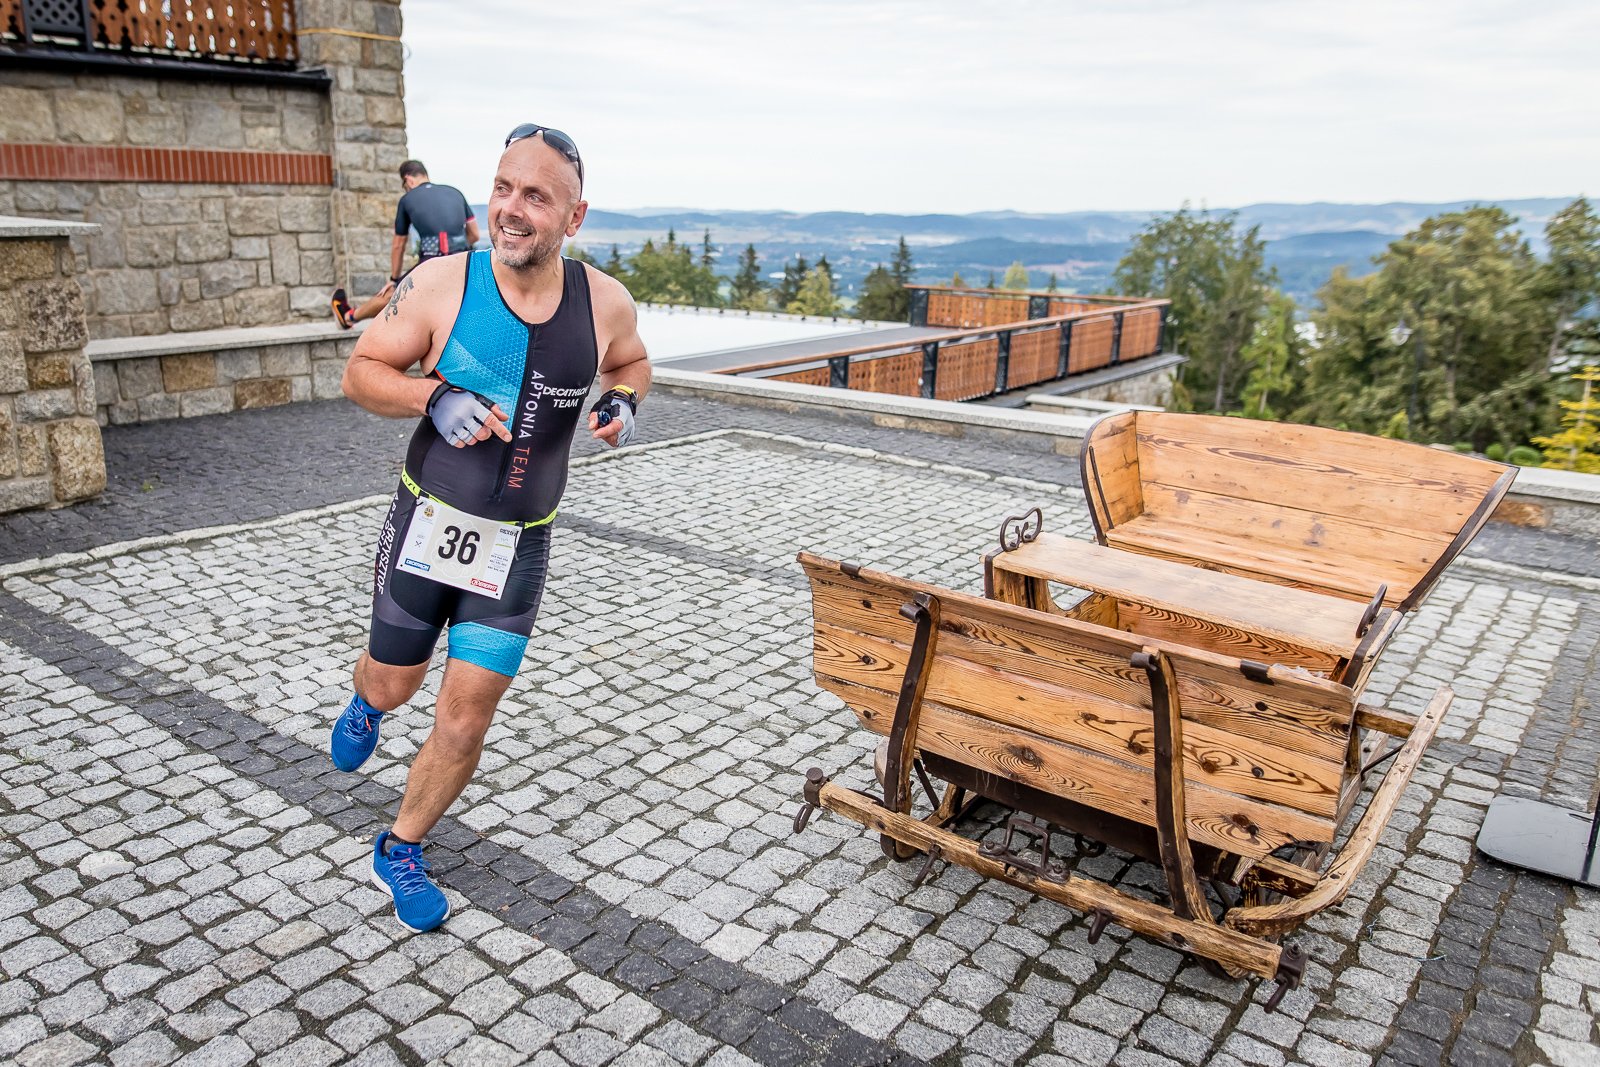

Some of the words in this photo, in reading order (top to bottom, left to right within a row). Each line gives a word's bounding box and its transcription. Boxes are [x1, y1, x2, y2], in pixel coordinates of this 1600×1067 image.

[518, 370, 545, 439] APTONIA
[543, 386, 589, 397] DECATHLON
[553, 399, 579, 408] TEAM
[507, 447, 530, 488] TEAM
[376, 523, 396, 595] KRZYSZTOF
[437, 525, 481, 565] 36
